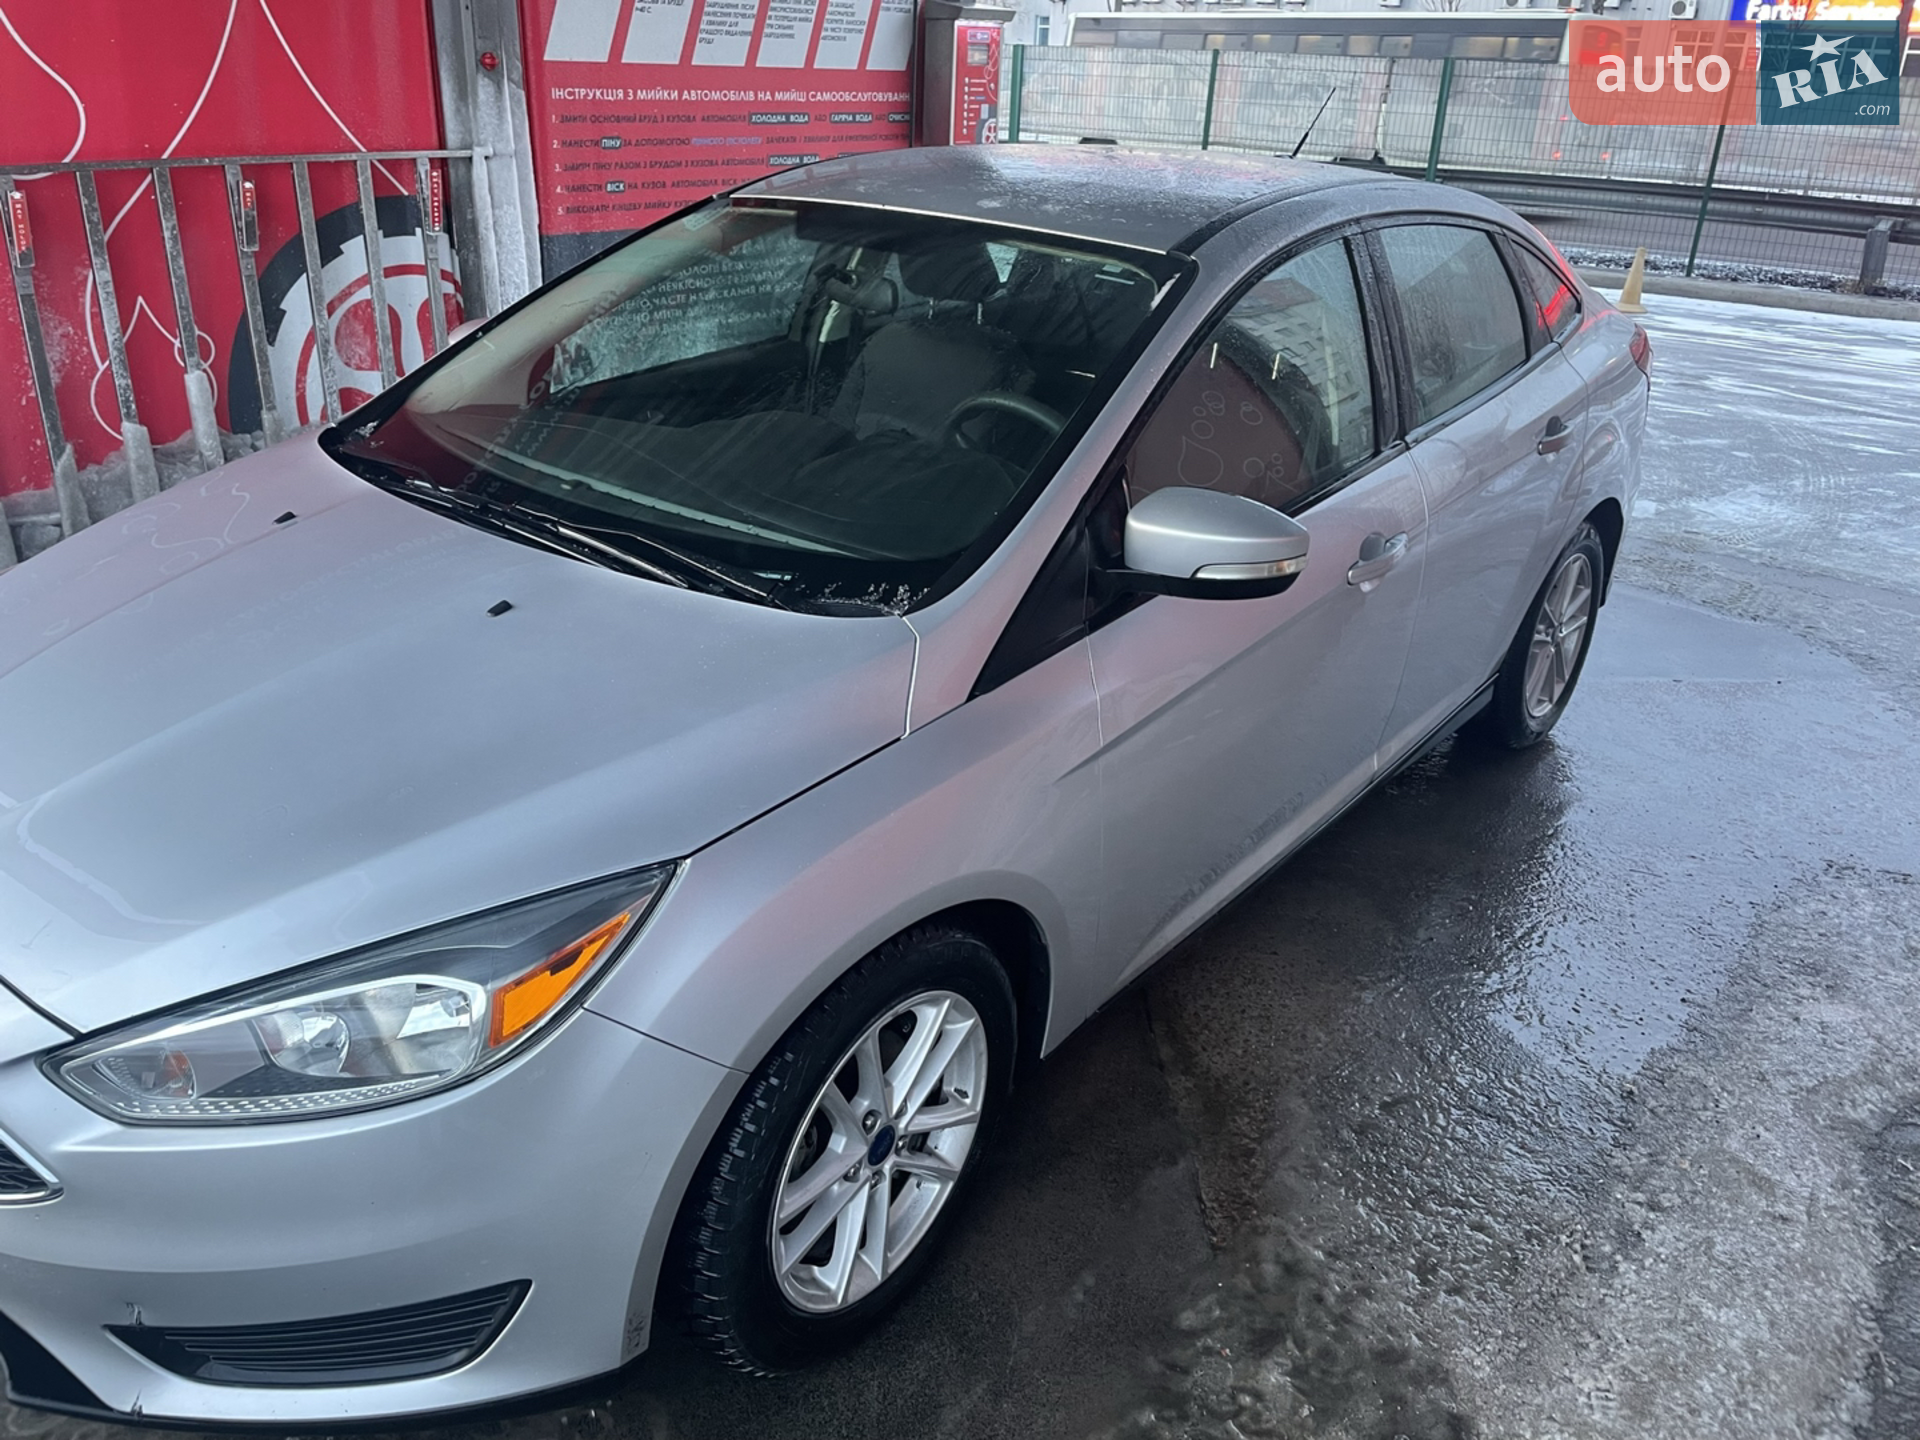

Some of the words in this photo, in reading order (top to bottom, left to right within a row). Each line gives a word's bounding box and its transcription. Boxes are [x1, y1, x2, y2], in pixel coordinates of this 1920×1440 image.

[551, 87, 623, 101] ІНСТРУКЦІЯ
[627, 89, 634, 100] З
[637, 87, 678, 100] МИЙКИ
[682, 90, 755, 101] АВТОМОБІЛІВ
[758, 91, 772, 101] НА
[774, 89, 806, 102] МИЙЦІ
[808, 91, 910, 102] САМООБСЛУГОВУВАНН
[589, 113, 637, 124] ОСНОВНИЙ
[639, 114, 658, 124] БРУД
[667, 114, 696, 123] КУЗОВА
[751, 114, 786, 123] ХОЛОДНА
[790, 114, 809, 123] ВОДА
[831, 114, 853, 122] ГАРЯЧА
[855, 114, 872, 122] ВОДА
[553, 140, 560, 149] 2.
[562, 139, 600, 148] НАНЕСТИ
[602, 139, 621, 148] ПІНУ
[623, 138, 632, 147] ЗА
[634, 138, 690, 147] ДОПОМОГОЮ
[554, 164, 562, 172] 3.
[592, 162, 612, 170] ПІНУ
[614, 161, 641, 170] РАЗОМ
[649, 160, 682, 169] БРУДОМ
[690, 159, 718, 167] КУЗОВА
[721, 157, 765, 166] АВТОМОБІЛЯ
[769, 156, 800, 164] ХОЛОДНА
[565, 184, 602, 193] НАНЕСТИ
[606, 182, 625, 191] ВІСК
[627, 182, 638, 190] НА
[641, 181, 666, 189] КУЗОВ
[611, 202, 641, 212] КІНЦЕВУ
[643, 200, 671, 209] МИЙКУ
